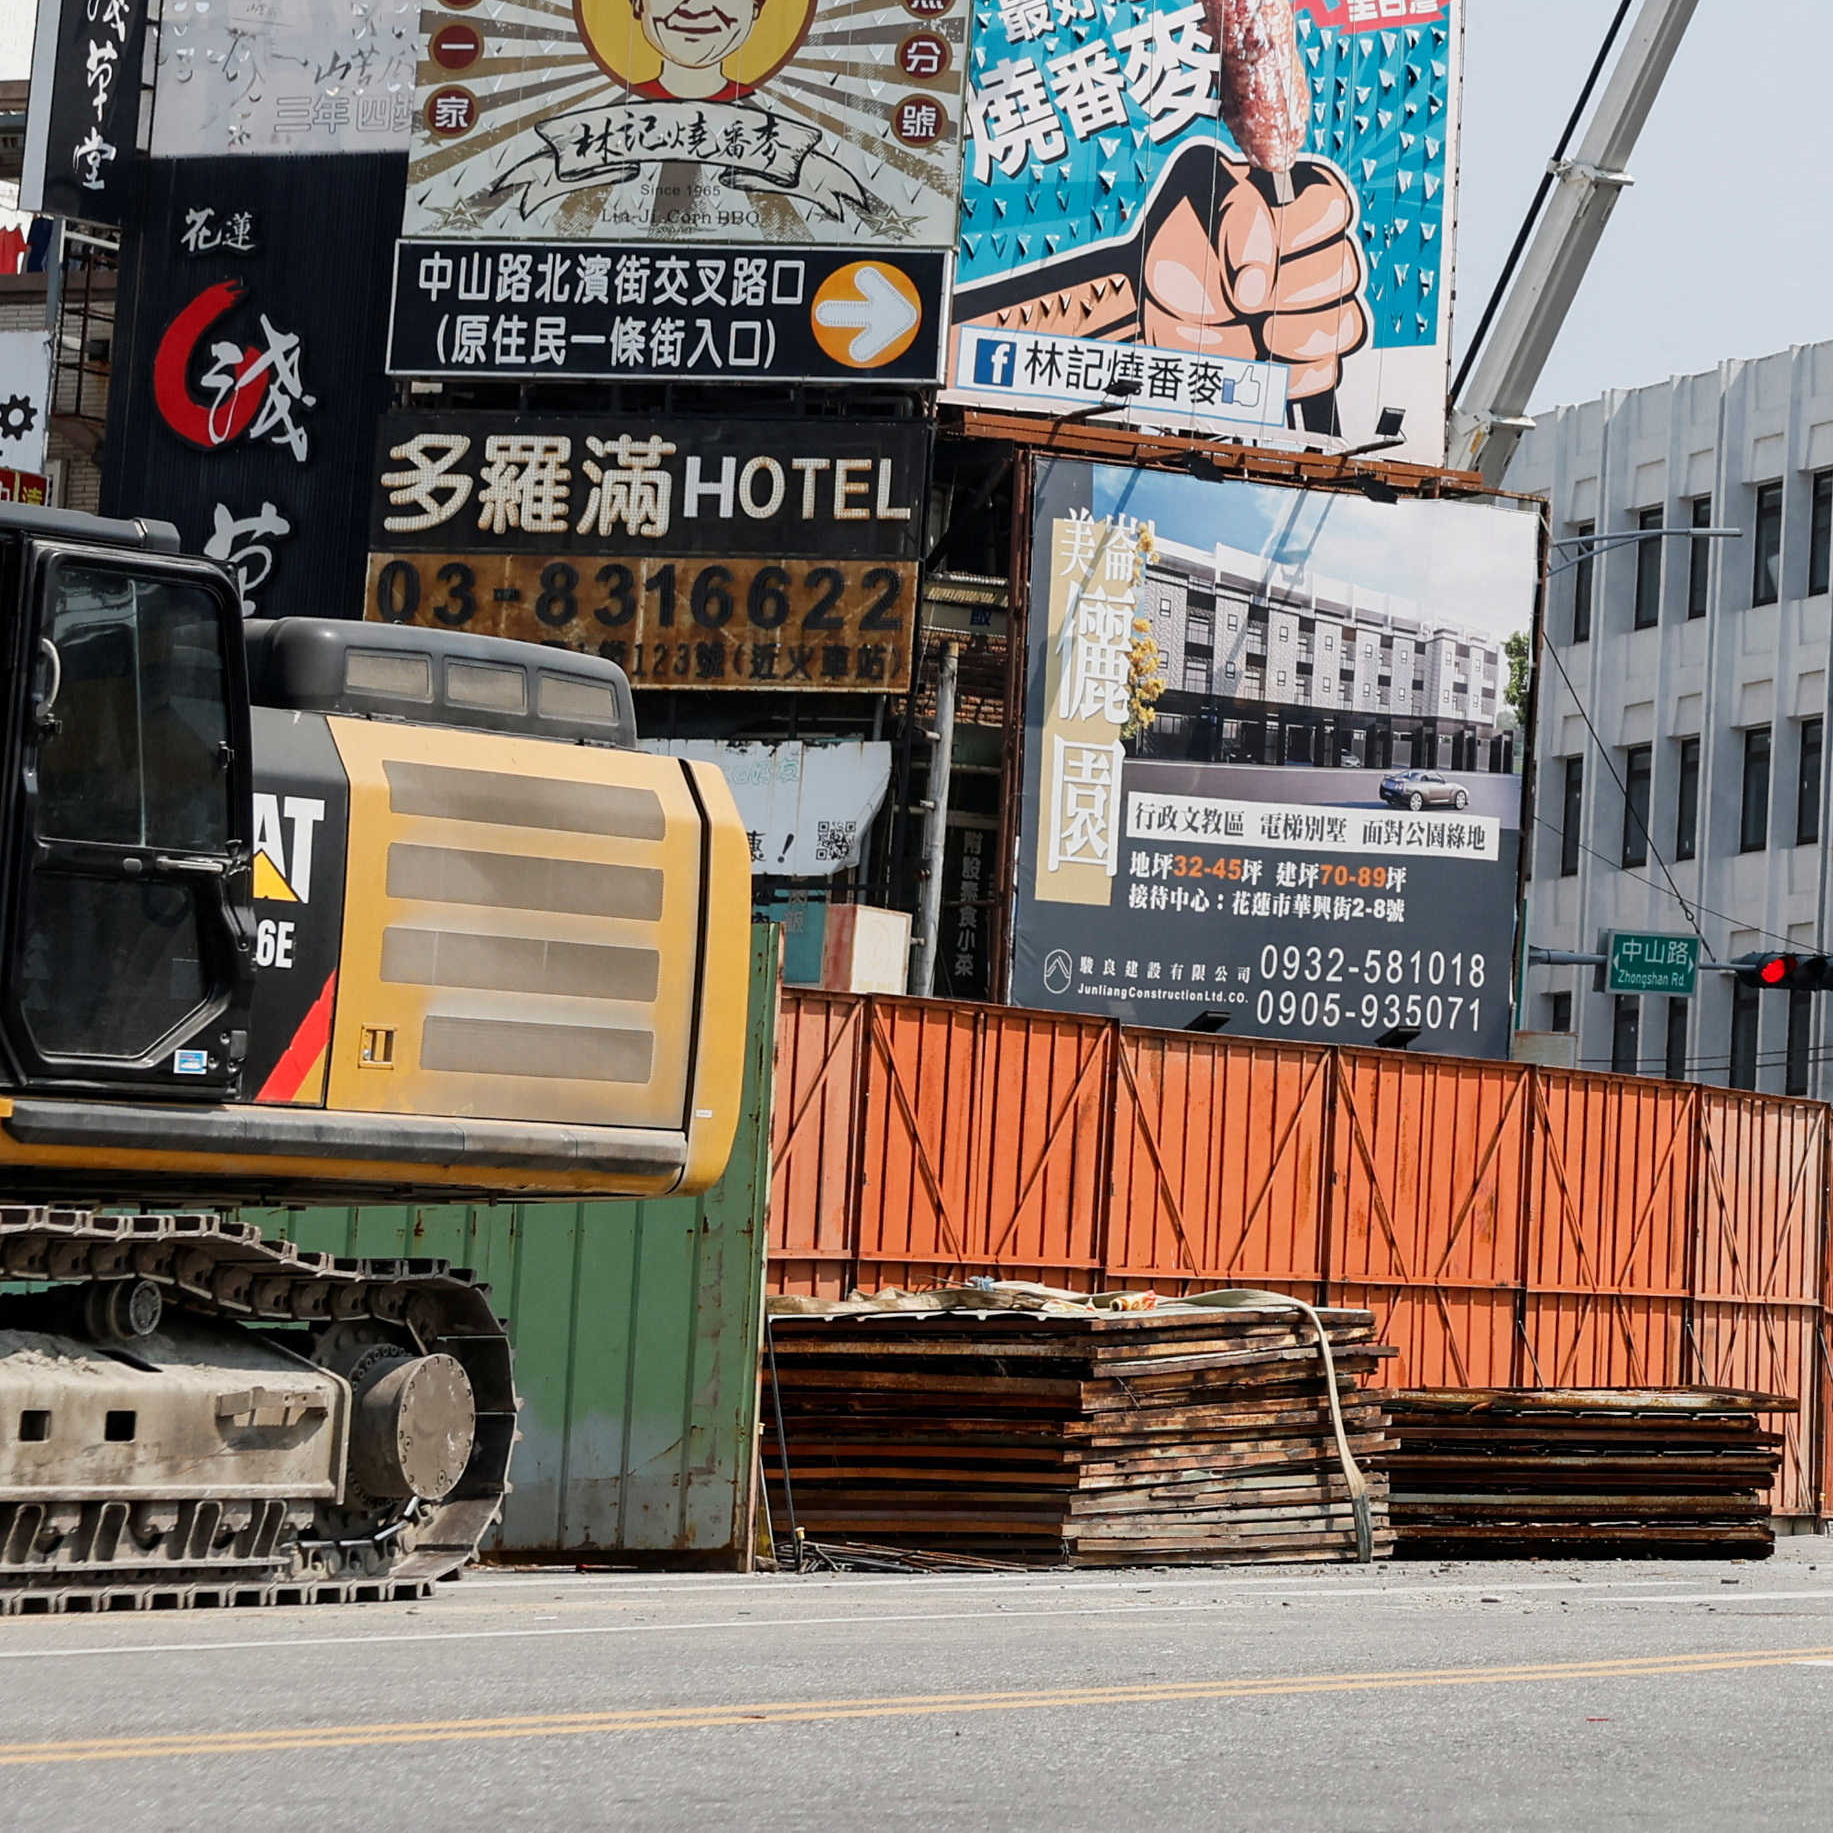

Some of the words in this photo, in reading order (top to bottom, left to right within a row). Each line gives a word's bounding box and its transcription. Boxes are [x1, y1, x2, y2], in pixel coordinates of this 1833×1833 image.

[962, 2, 1221, 184] 燒番麥
[640, 183, 681, 197] Since
[687, 184, 721, 197] 1965
[717, 210, 760, 228] BBQ
[417, 250, 806, 307] 中山路北濱街交叉路口
[436, 315, 776, 370] (原住民一條街入口)
[1024, 337, 1224, 406] 林記燒番麥
[379, 432, 677, 538] 多羅滿
[683, 455, 911, 521] HOTEL
[377, 559, 902, 632] 03-8316622
[1134, 801, 1246, 838] 行政文教區
[1259, 811, 1348, 846] 電梯別墅
[1361, 818, 1486, 851] 面對公園綠地
[1129, 850, 1263, 882] 地坪32-45坪
[1275, 860, 1408, 893] 建坪70-89坪
[1259, 943, 1486, 989] 0932-581018
[1622, 937, 1689, 965] 中山路
[1617, 970, 1669, 989] Zhongshan
[1255, 989, 1482, 1033] 0905-935071
